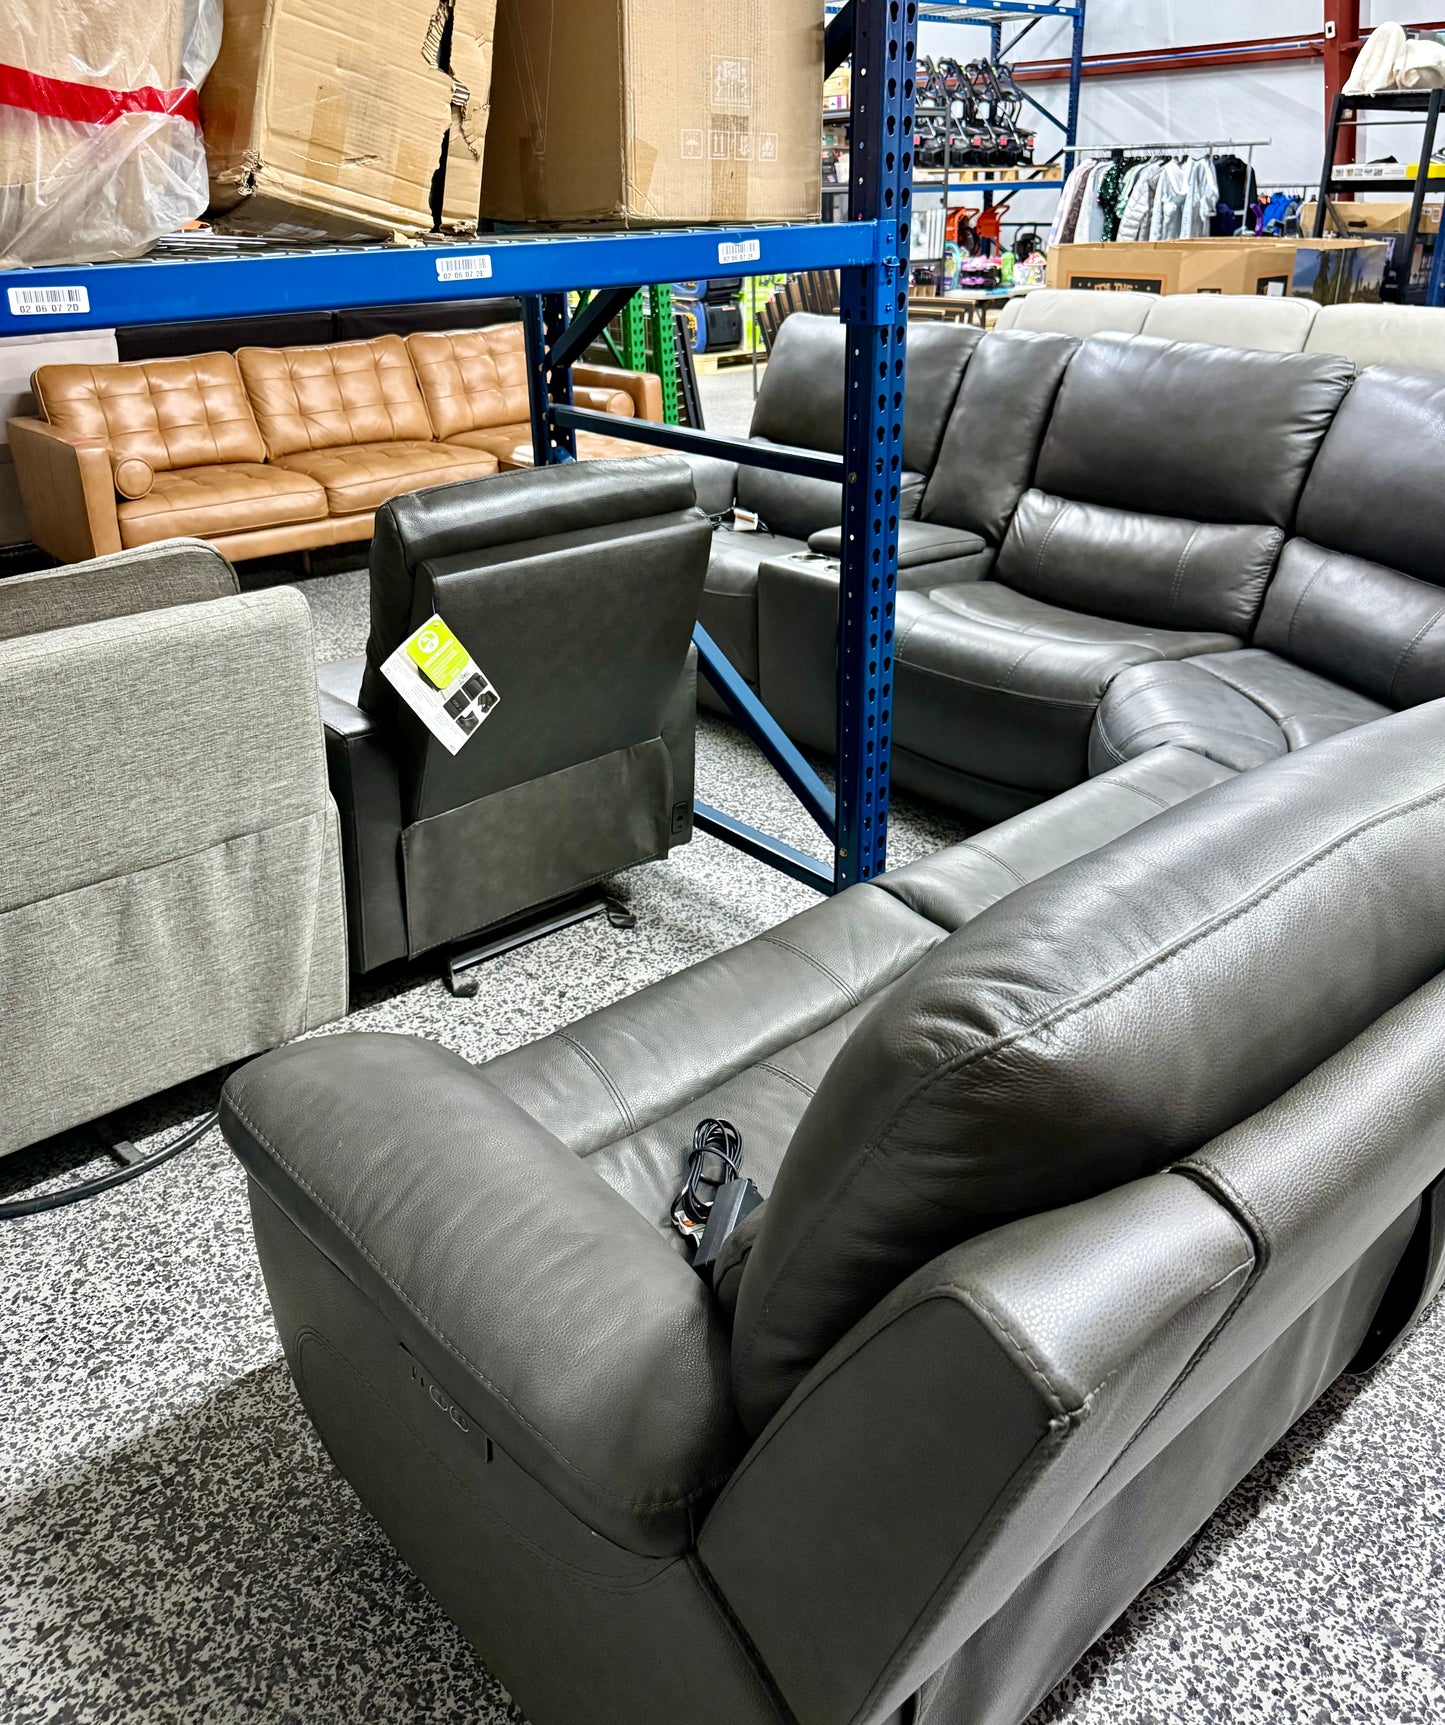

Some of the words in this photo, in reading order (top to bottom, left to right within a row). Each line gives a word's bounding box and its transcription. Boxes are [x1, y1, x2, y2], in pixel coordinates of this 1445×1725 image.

[19, 305, 31, 313] 02
[51, 304, 62, 312] 07
[67, 303, 79, 312] 2D
